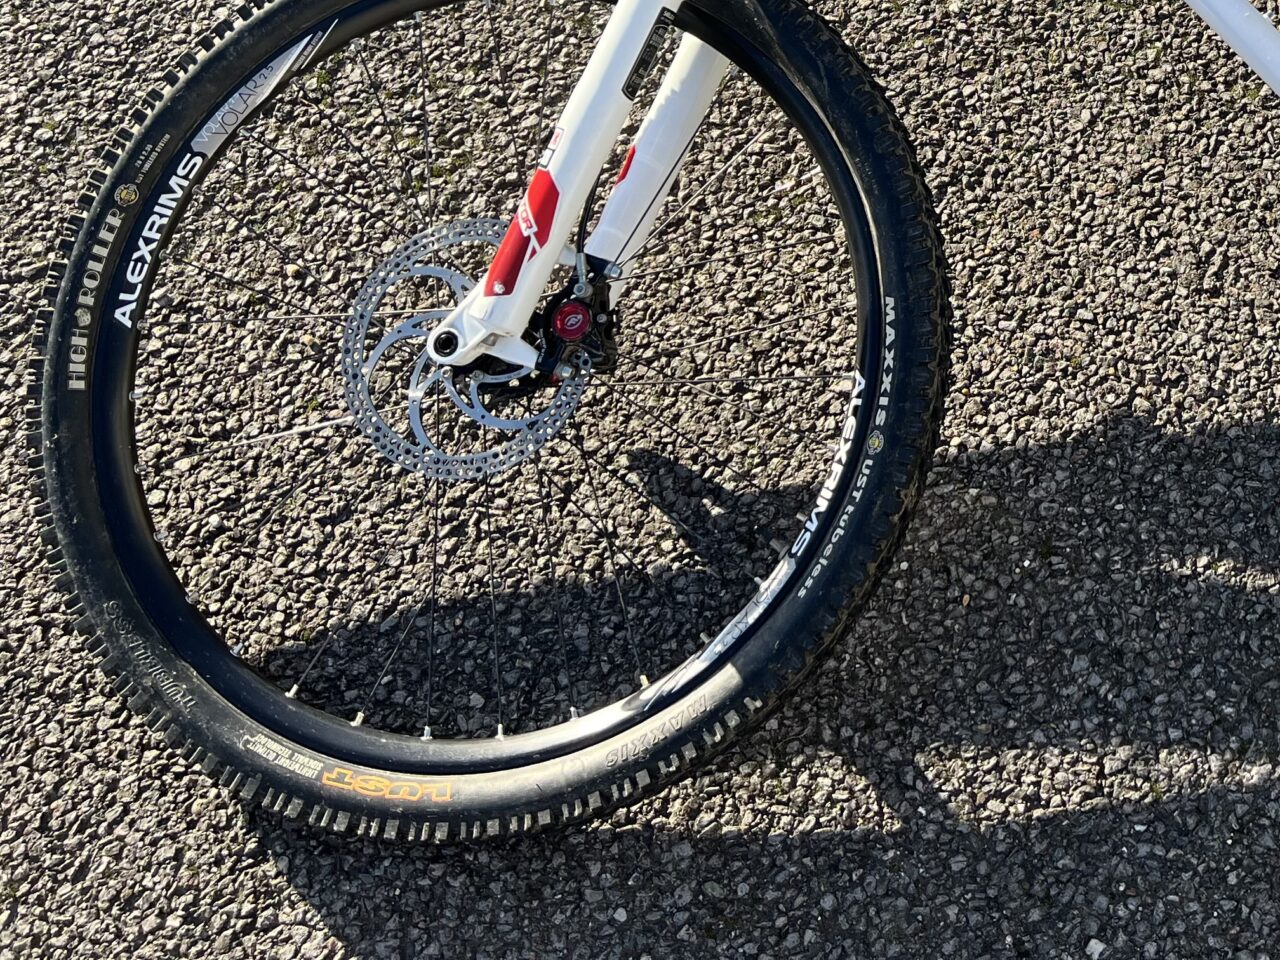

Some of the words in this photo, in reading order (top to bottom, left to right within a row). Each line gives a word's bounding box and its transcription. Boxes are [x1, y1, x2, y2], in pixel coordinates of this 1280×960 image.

[211, 80, 263, 134] VOLAR
[259, 64, 275, 81] 2.5
[76, 207, 126, 306] ROLLER
[113, 152, 204, 329] ALEXRIMS
[67, 328, 90, 390] HIGH
[874, 295, 896, 426] MAXXIS
[789, 369, 866, 558] ALEXRIMS
[851, 458, 874, 505] UST
[796, 504, 855, 601] tubeless
[605, 694, 712, 769] MAXXIS
[321, 766, 452, 802] LUST
